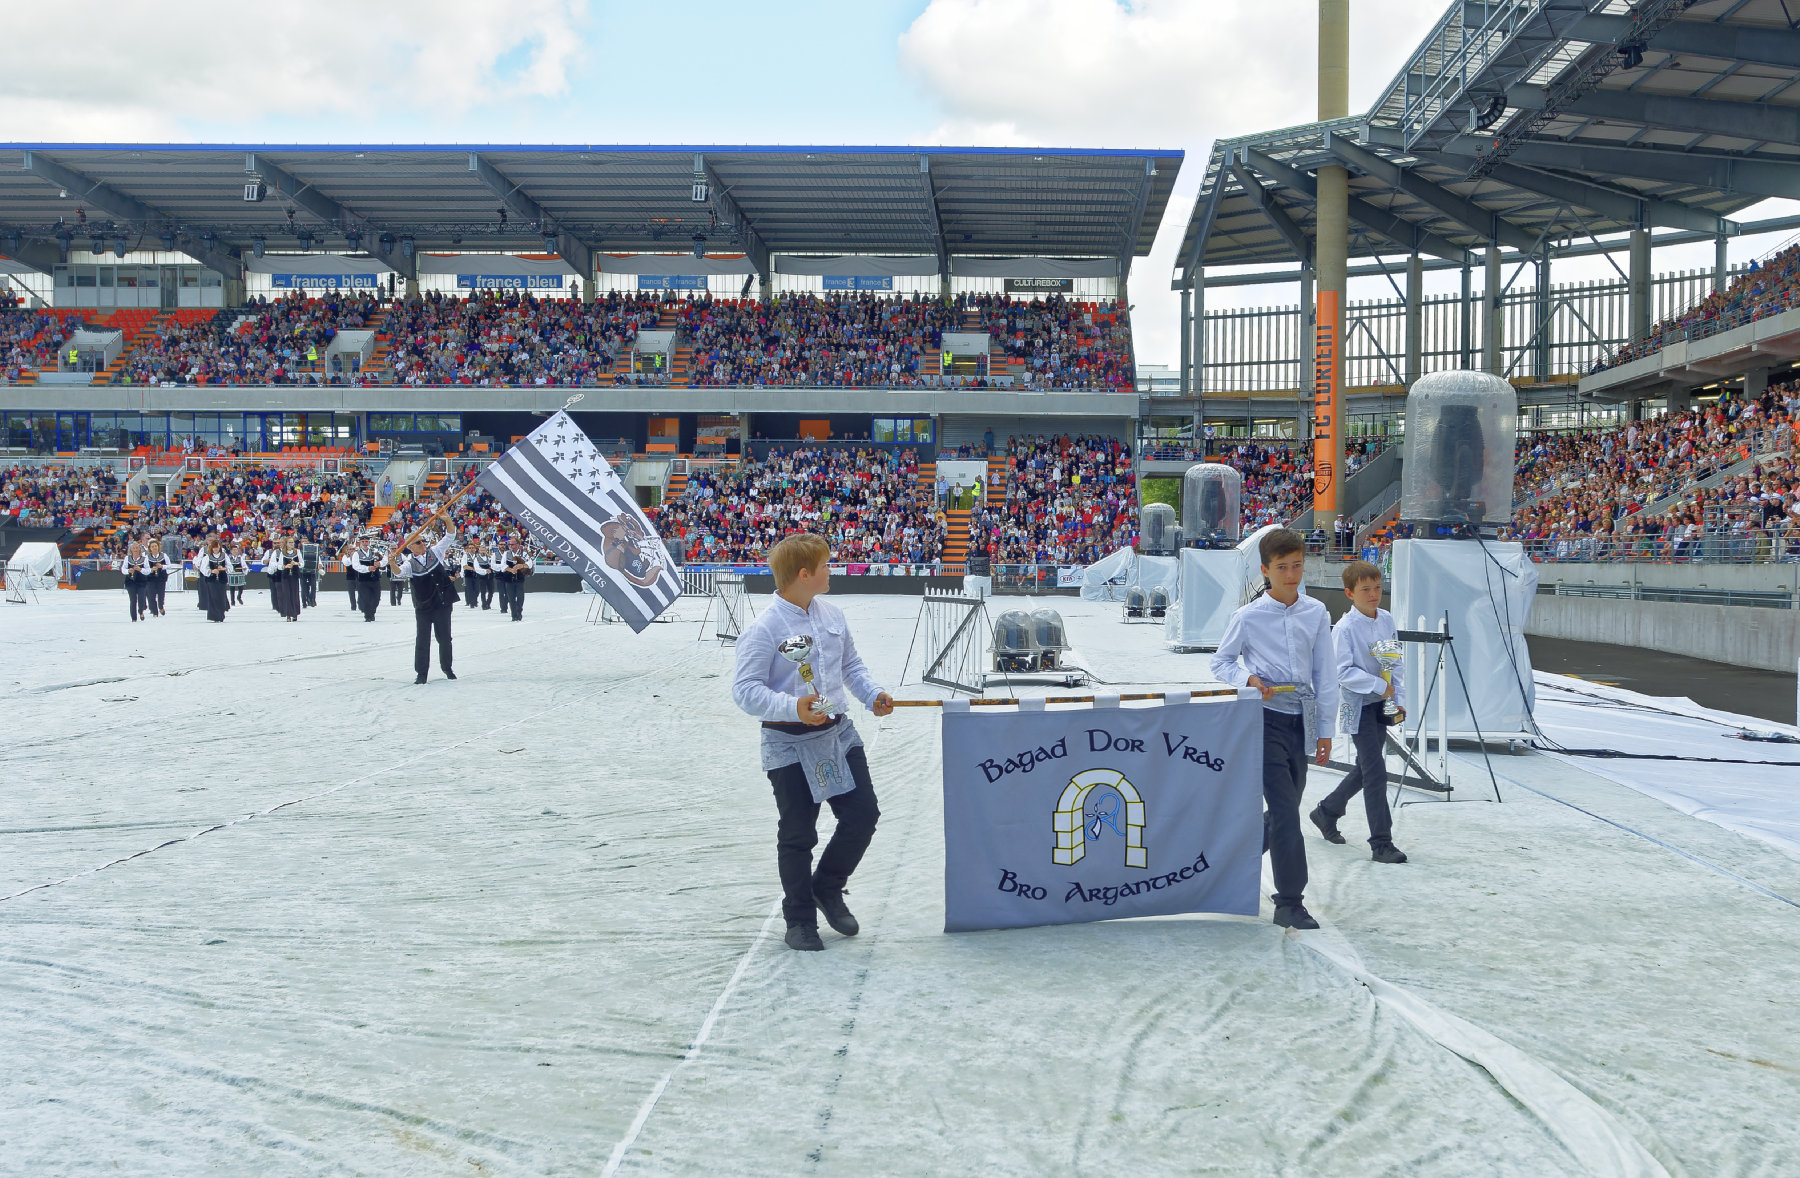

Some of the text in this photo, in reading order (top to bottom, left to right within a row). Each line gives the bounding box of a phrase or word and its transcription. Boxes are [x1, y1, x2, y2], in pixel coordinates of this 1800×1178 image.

[291, 275, 336, 287] france
[342, 275, 372, 287] bleu
[476, 276, 521, 288] france
[527, 276, 557, 288] bleu
[1315, 415, 1331, 439] FC
[520, 509, 559, 543] Bagad
[975, 728, 1225, 783] Bagad Dor Vras
[998, 851, 1210, 906] Bro Argantred
